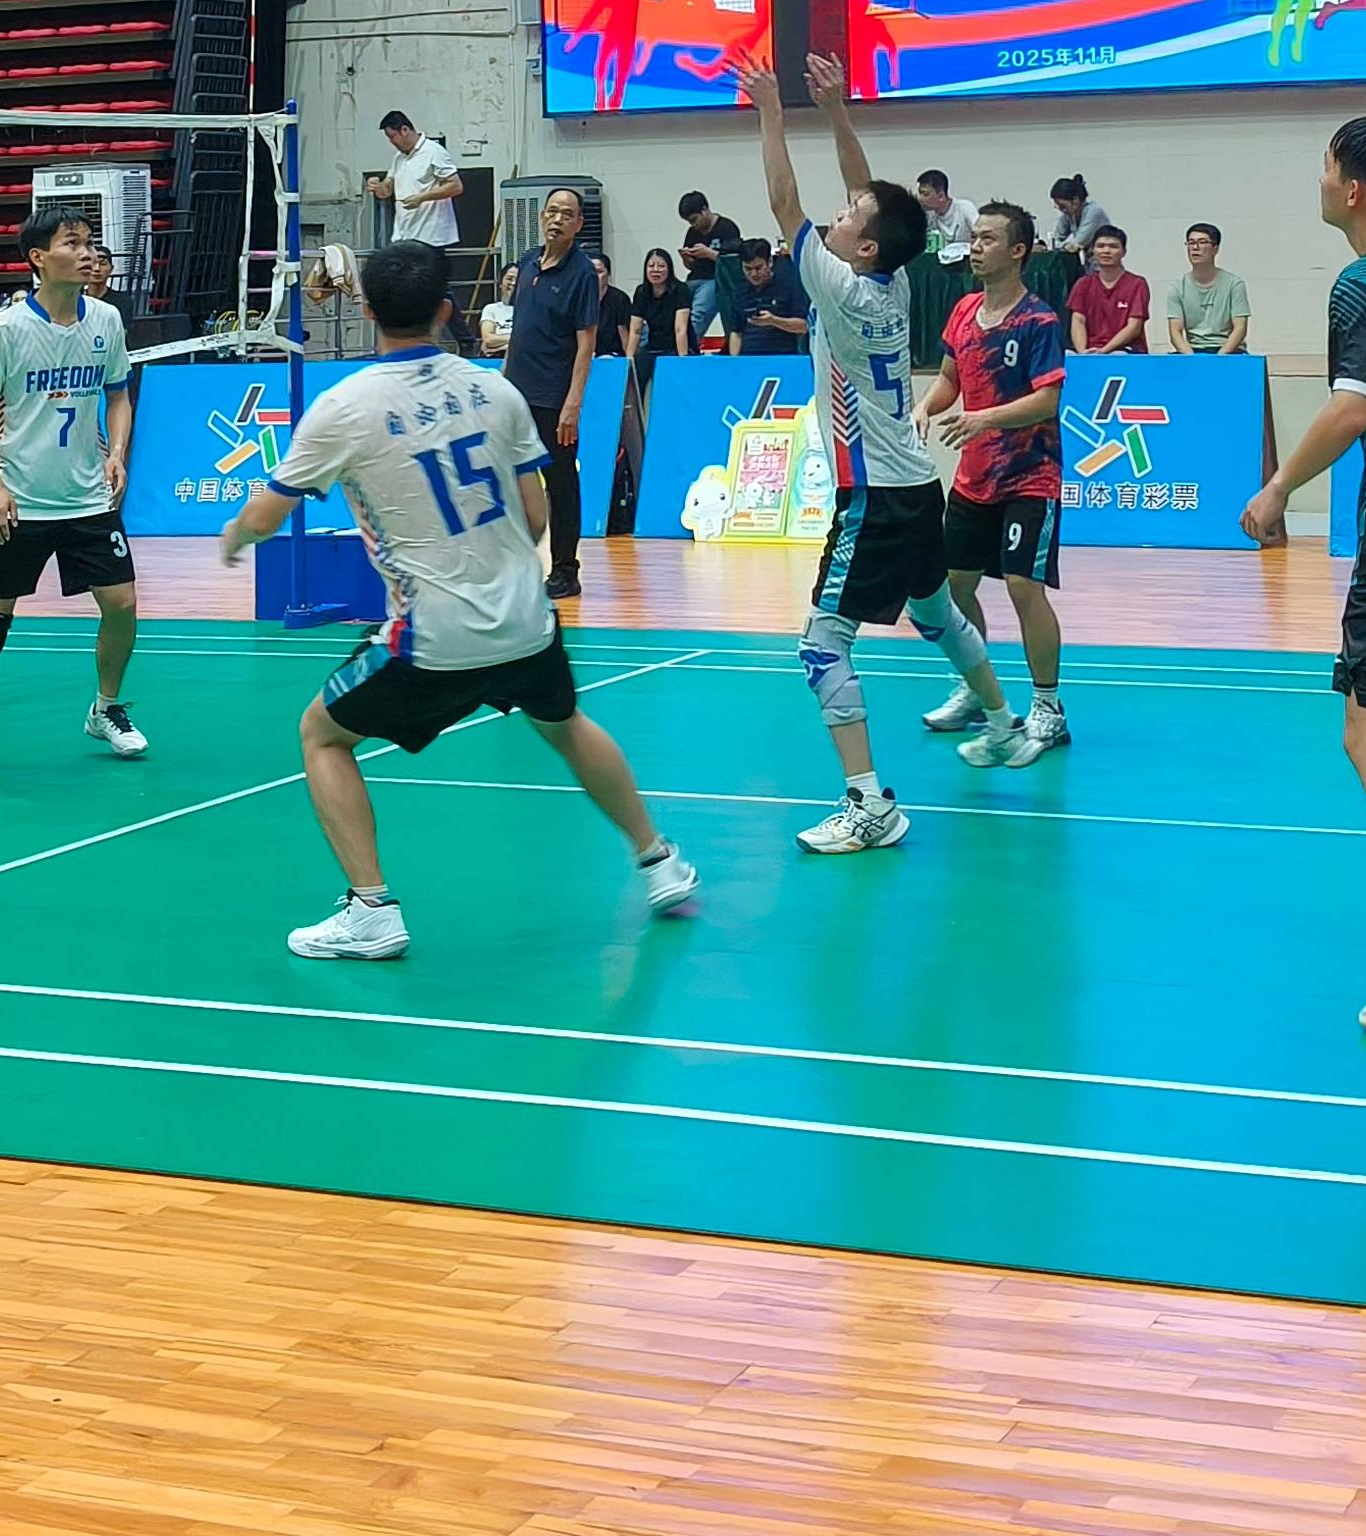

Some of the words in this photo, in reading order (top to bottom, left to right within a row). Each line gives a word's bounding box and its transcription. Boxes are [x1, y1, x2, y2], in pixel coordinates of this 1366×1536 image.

[997, 46, 1115, 67] 2025年11月
[1004, 339, 1019, 366] 9
[869, 351, 903, 420] 5
[56, 407, 76, 447] 7
[412, 431, 506, 536] 15
[110, 530, 128, 558] 3
[1007, 522, 1022, 551] 9
